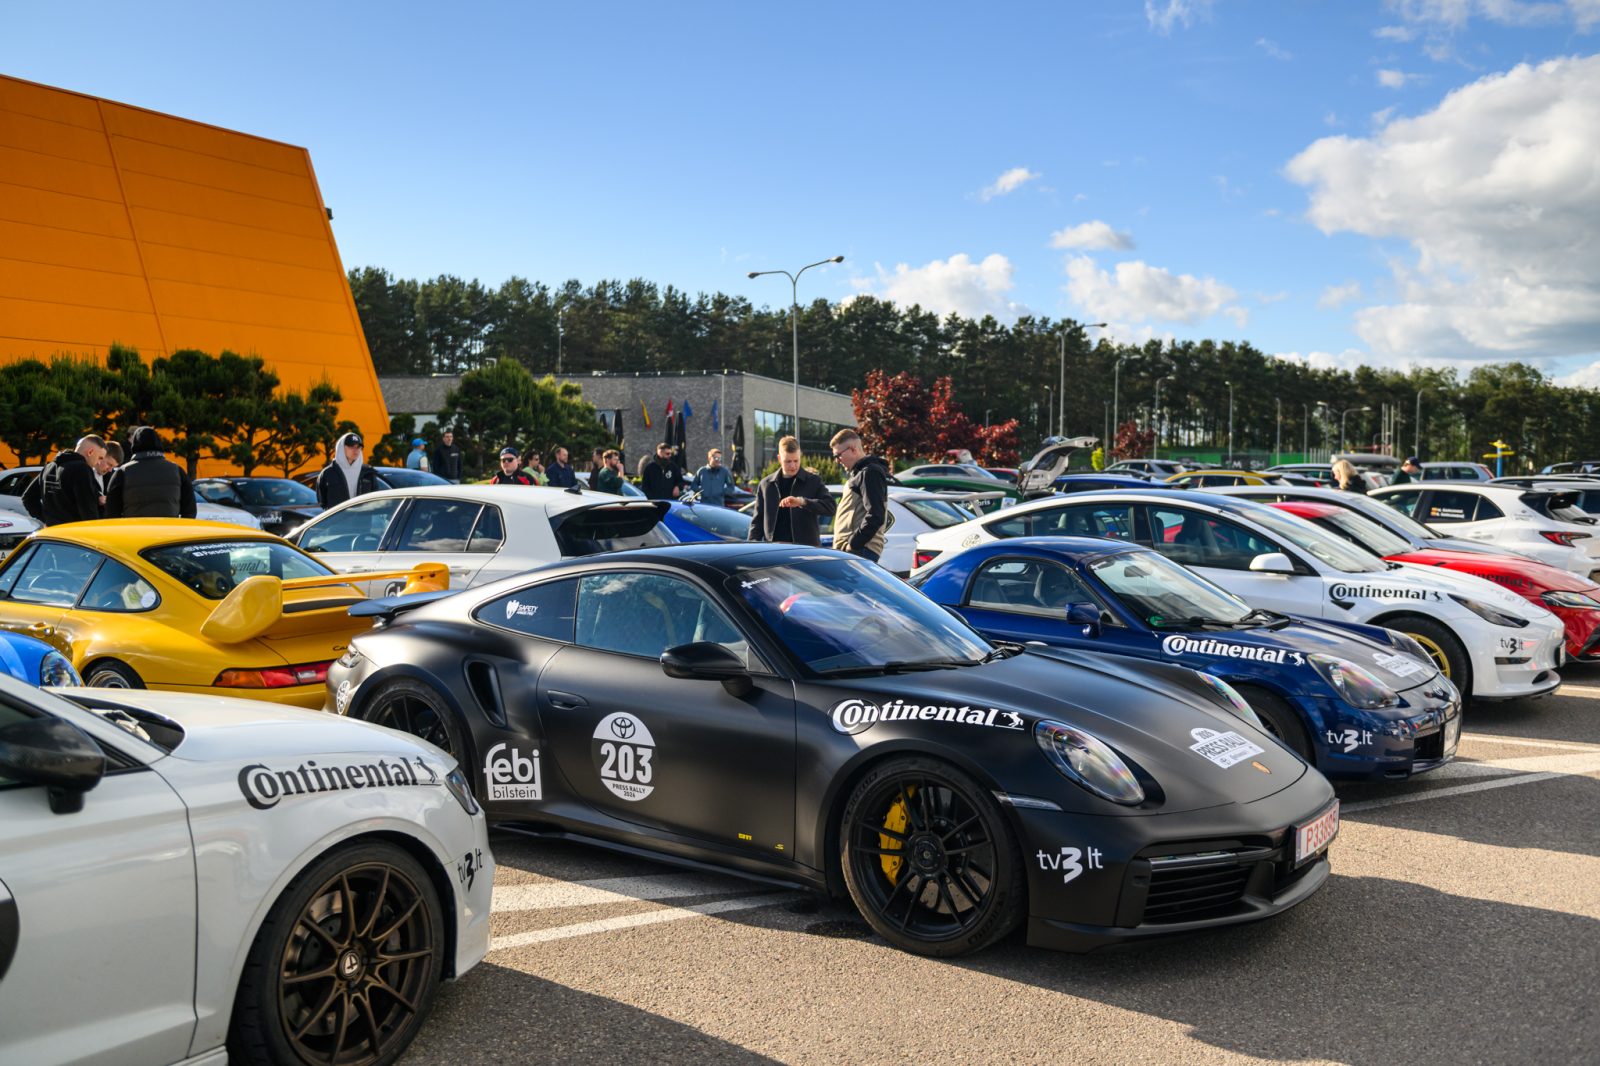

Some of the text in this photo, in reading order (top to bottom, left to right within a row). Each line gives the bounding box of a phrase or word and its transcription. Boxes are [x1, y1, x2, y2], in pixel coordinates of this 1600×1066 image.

[1328, 583, 1427, 600] Continental
[1162, 635, 1286, 664] Continental
[832, 699, 999, 732] Continental
[1326, 729, 1373, 753] tv3.lt
[483, 743, 543, 784] febi
[600, 742, 653, 784] 203
[238, 756, 419, 810] Continental
[494, 786, 537, 799] bilstein
[612, 783, 646, 794] PRESS RALLY
